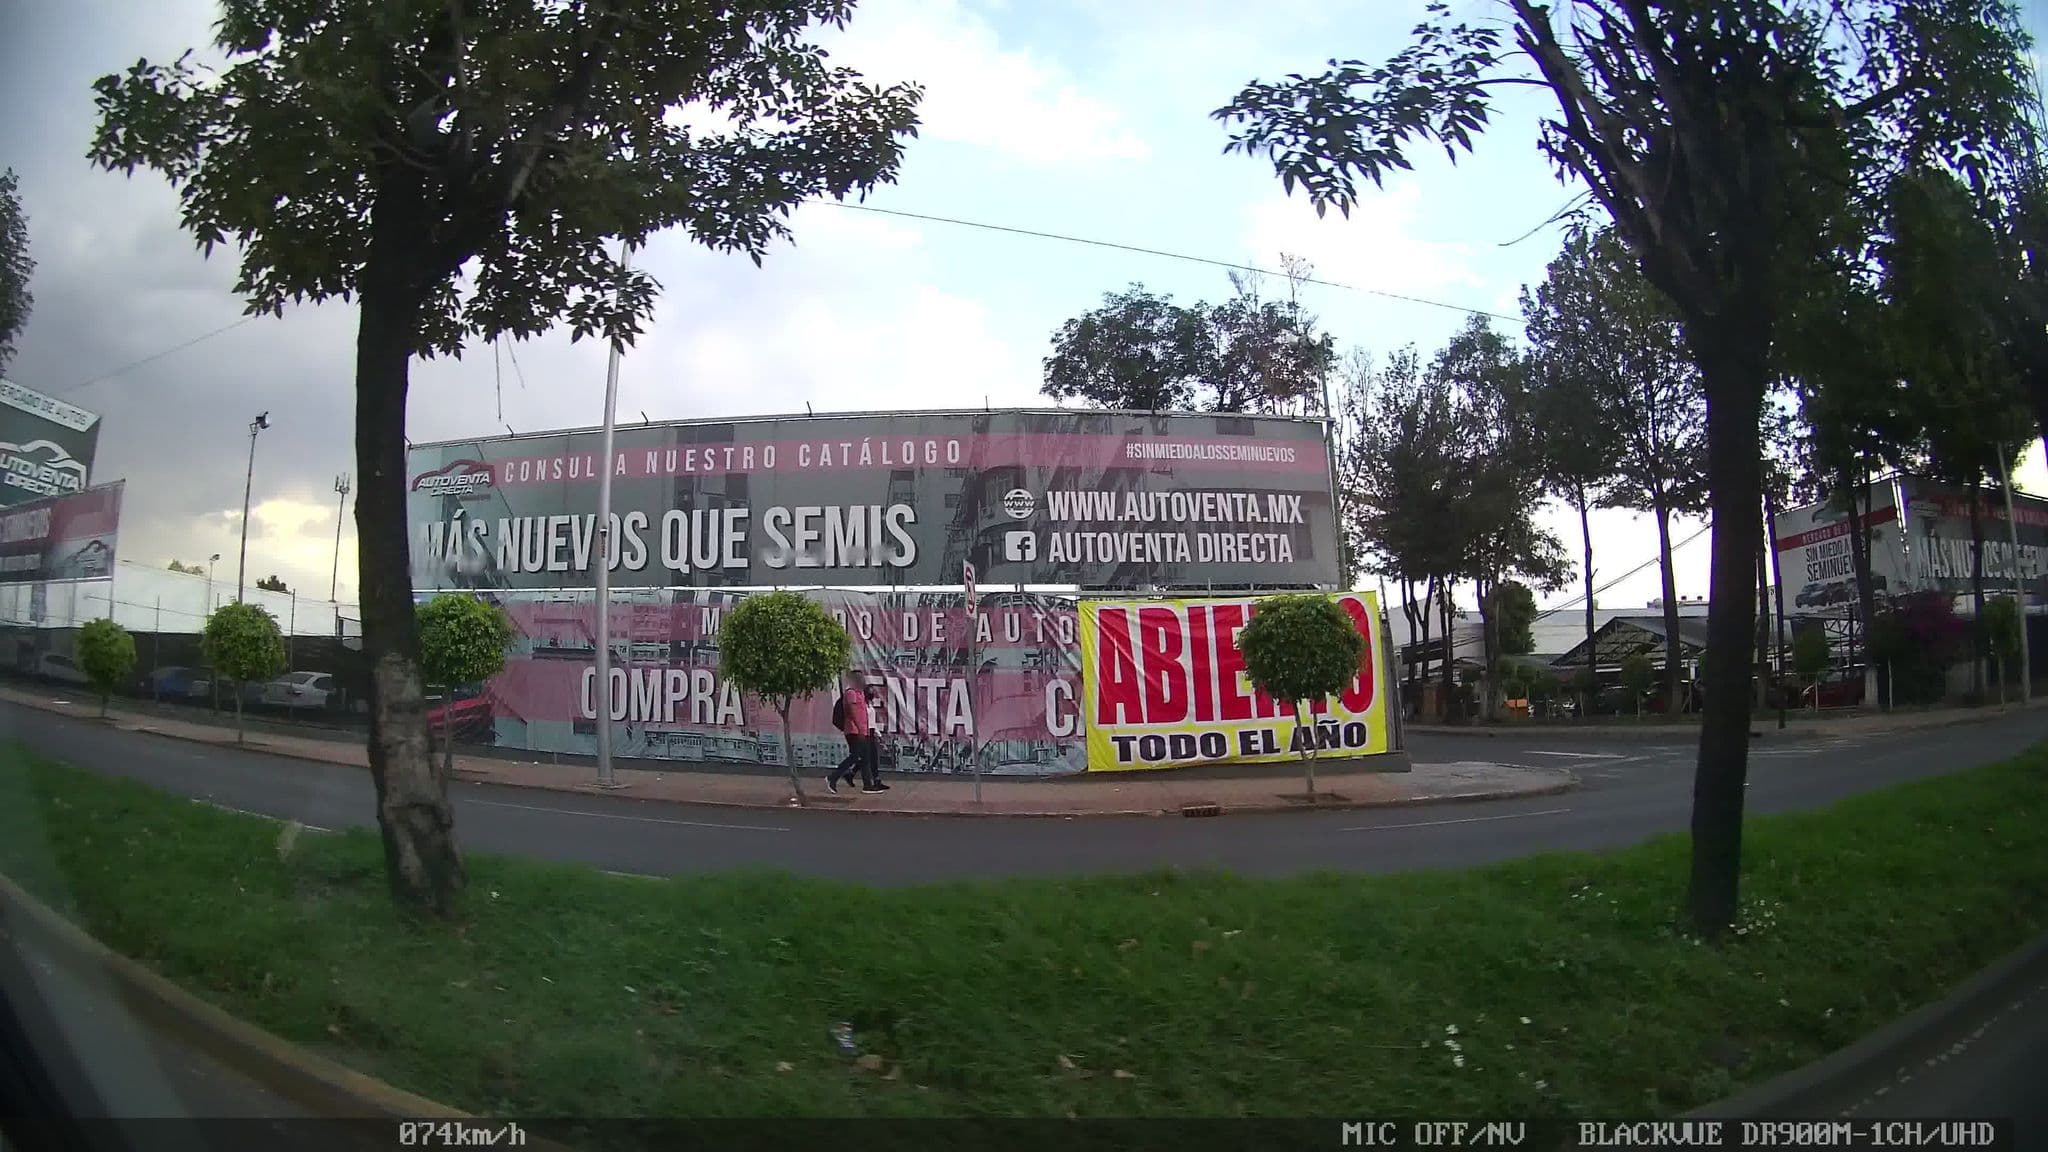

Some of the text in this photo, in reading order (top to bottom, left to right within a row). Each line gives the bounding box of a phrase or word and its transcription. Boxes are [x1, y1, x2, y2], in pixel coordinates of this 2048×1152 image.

[505, 437, 960, 483] CONSULA NUESTRO CATÁLOGO
[1126, 443, 1295, 463] #SINMIEDOALOSSEMINUEVOS
[417, 473, 490, 489] AUTOVENTA
[431, 485, 473, 498] DIRECTA
[1047, 491, 1304, 524] WWW.AUTOVENTA.MX
[424, 508, 488, 573] MÁS
[661, 508, 750, 574] QUE
[763, 504, 918, 569] SEMIS
[1048, 532, 1192, 563] AUTOVENTA
[1198, 533, 1294, 564] DIRECTA
[903, 613, 947, 642] DE
[1098, 597, 1375, 725] ABIEO
[581, 667, 745, 726] COMPRA
[1111, 719, 1367, 763] TODO EL AÑO
